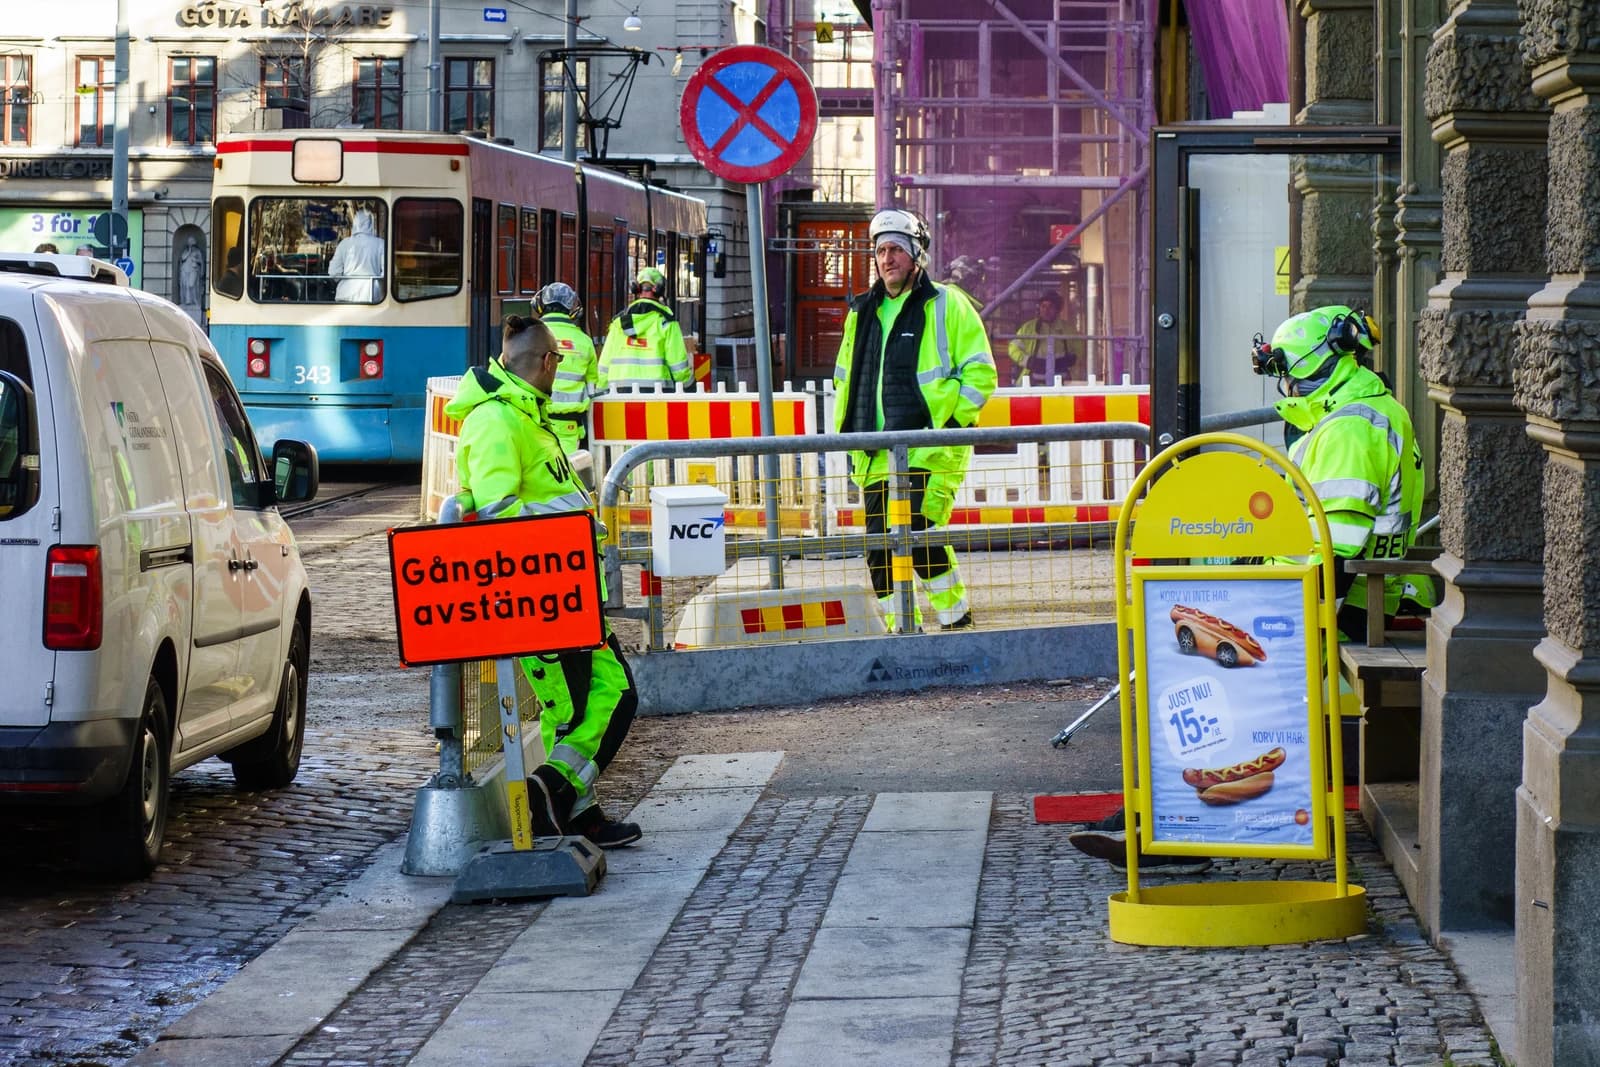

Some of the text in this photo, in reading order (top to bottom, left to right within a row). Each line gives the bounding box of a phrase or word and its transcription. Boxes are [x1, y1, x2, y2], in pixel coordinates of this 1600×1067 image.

[179, 2, 251, 26] GÖTA
[31, 214, 44, 232] 3
[50, 212, 81, 233] för
[294, 364, 331, 385] 343
[669, 523, 714, 540] NCC
[1169, 516, 1254, 539] Pressbyrån
[401, 550, 586, 587] Gångbana
[413, 584, 583, 626] avstängd
[1168, 682, 1212, 711] JUST NU!
[1252, 731, 1275, 743] KORV
[1276, 731, 1285, 743] VI
